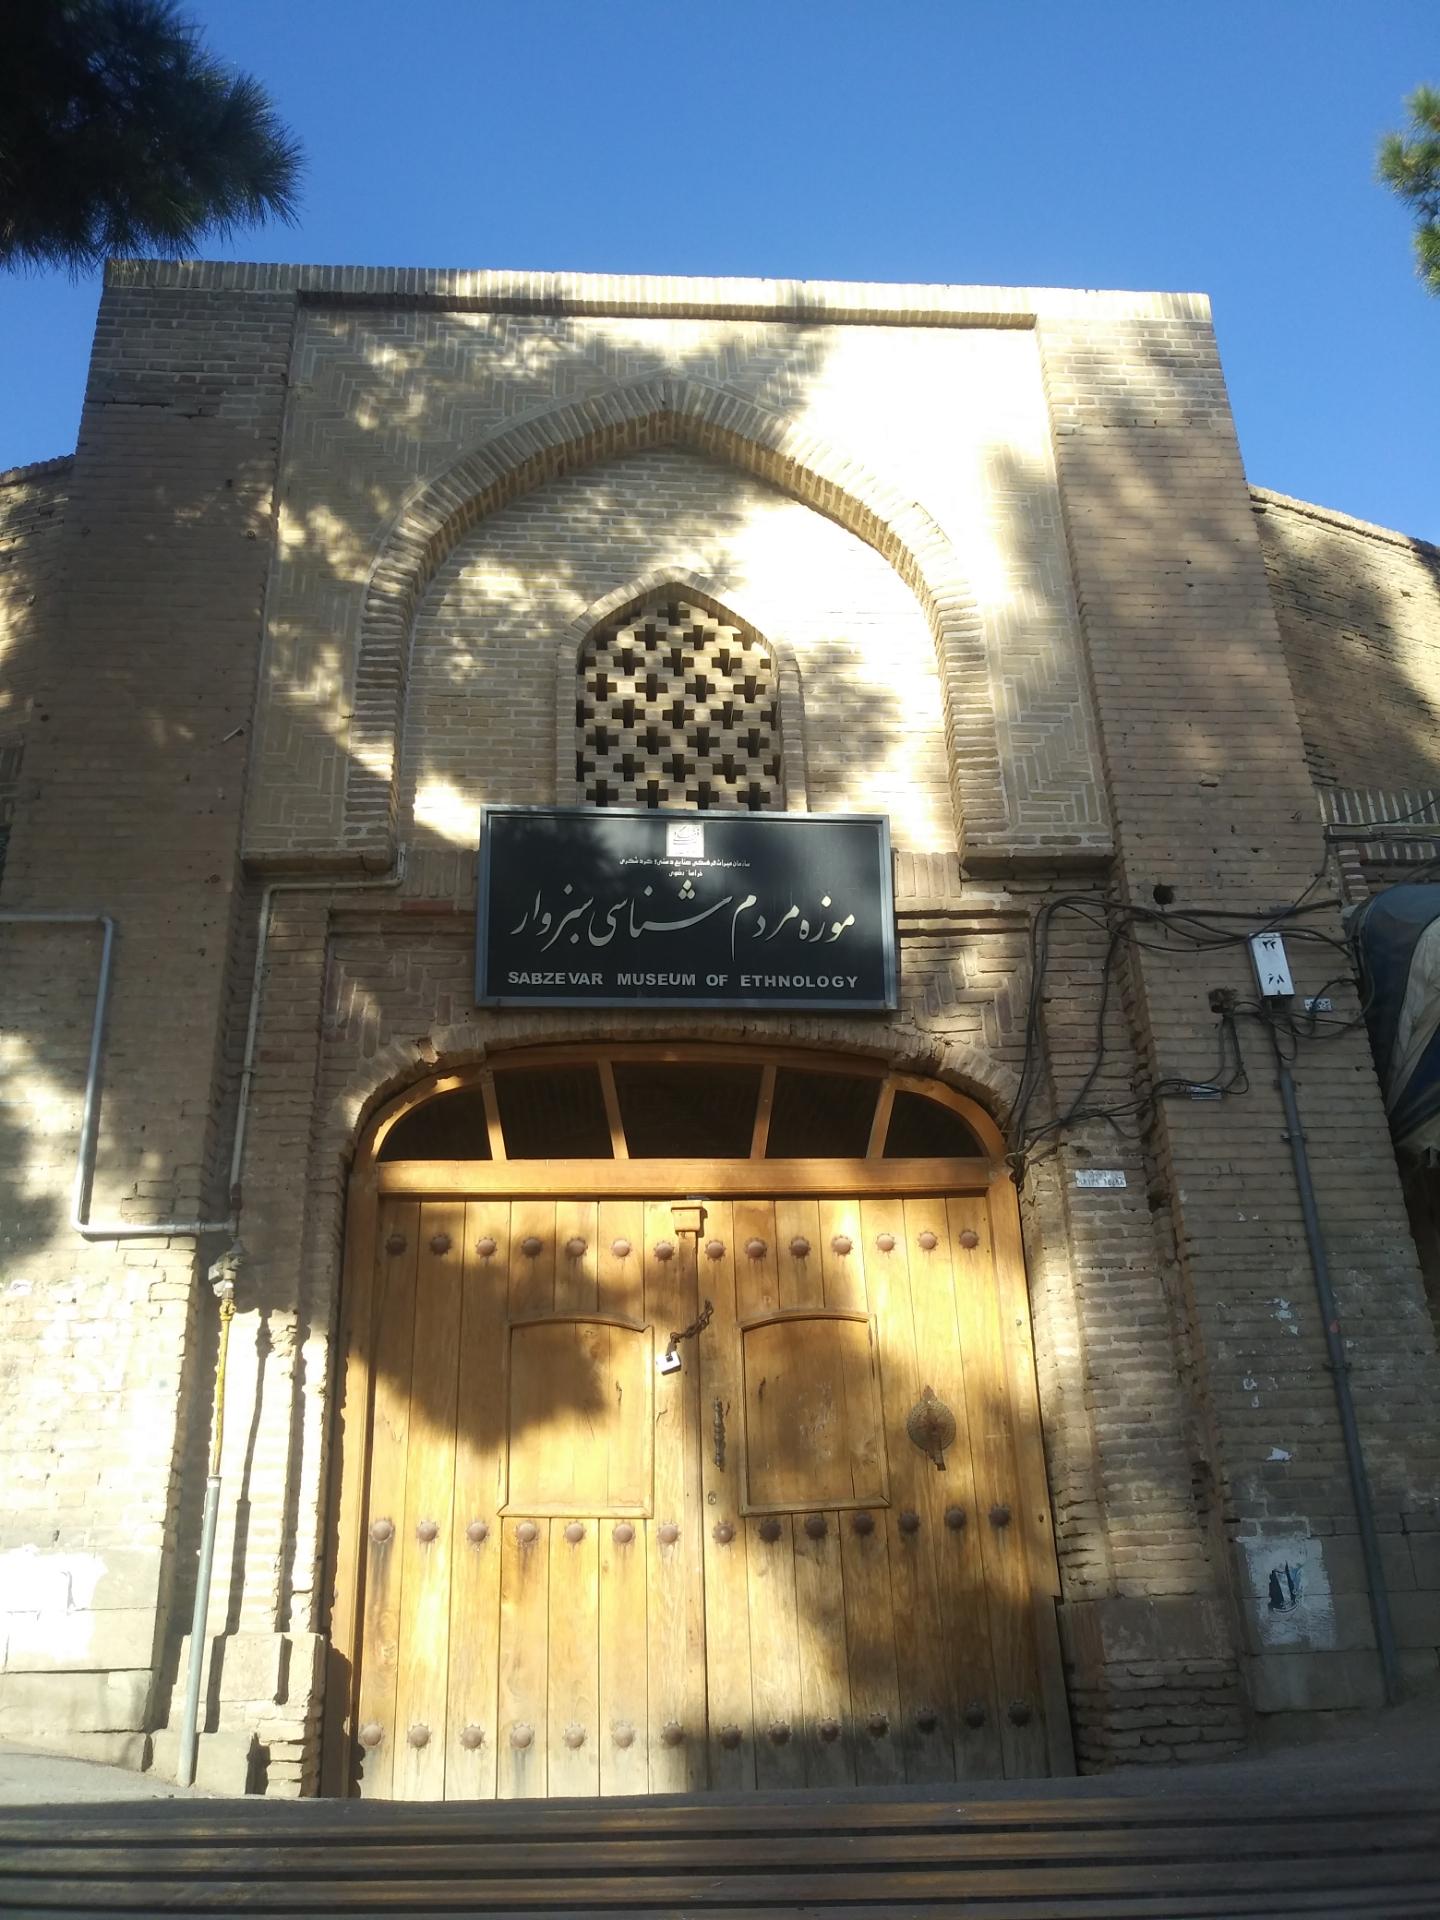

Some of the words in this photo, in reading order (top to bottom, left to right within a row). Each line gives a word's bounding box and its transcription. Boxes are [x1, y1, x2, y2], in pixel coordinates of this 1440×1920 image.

[509, 883, 595, 953] سبزوار
[588, 879, 733, 947] شناسی
[731, 894, 800, 962] مردم
[798, 895, 855, 943] موزه
[507, 971, 603, 985] SABZEVAR
[616, 972, 697, 986] MUSEUM
[705, 974, 729, 987] OF
[740, 974, 859, 988] ETHNOLOGY
